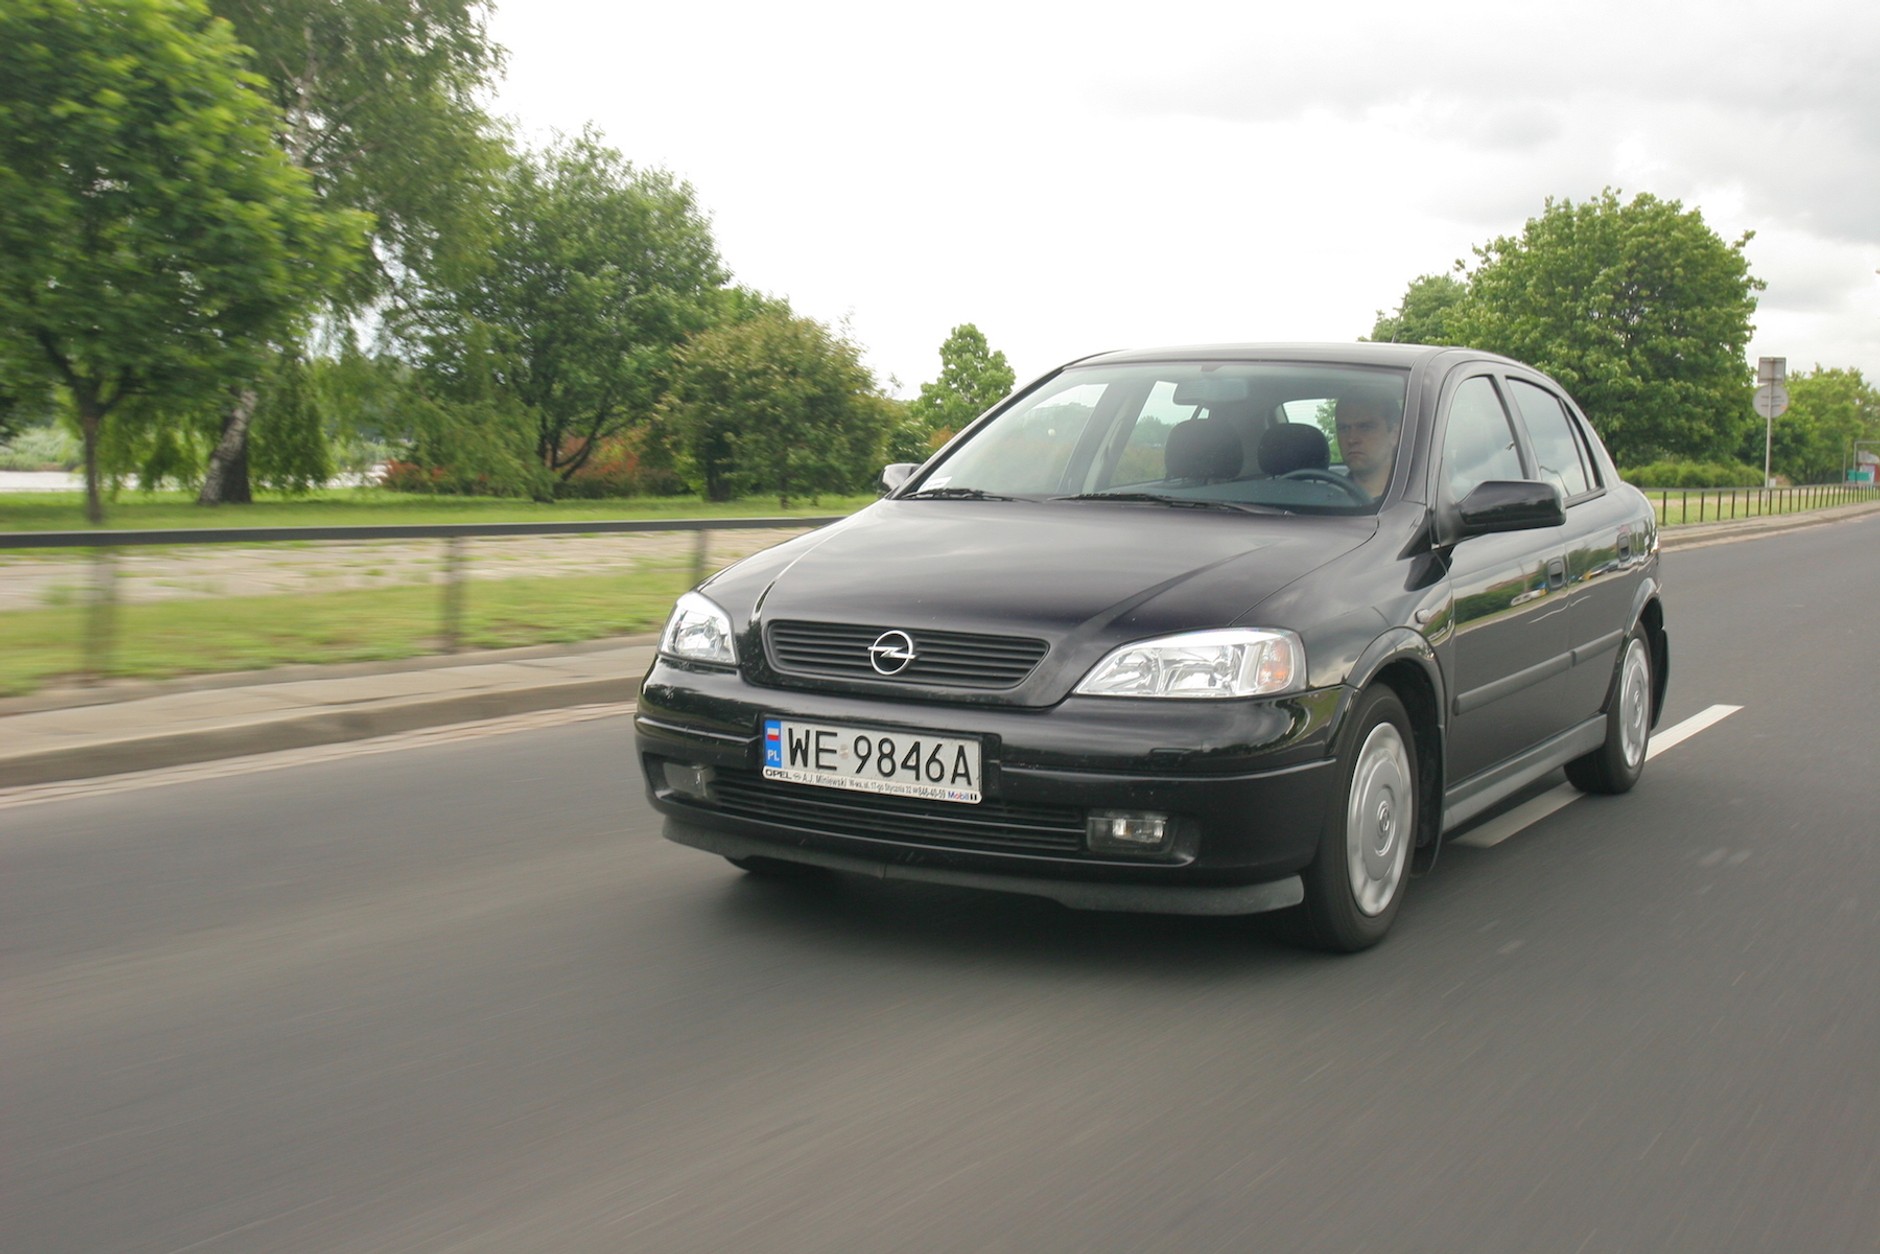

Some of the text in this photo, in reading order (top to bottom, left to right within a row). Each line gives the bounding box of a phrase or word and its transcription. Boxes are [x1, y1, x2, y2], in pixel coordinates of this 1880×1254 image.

[767, 750, 780, 762] PL
[788, 728, 972, 787] WE 9846A
[765, 768, 792, 780] OPEL
